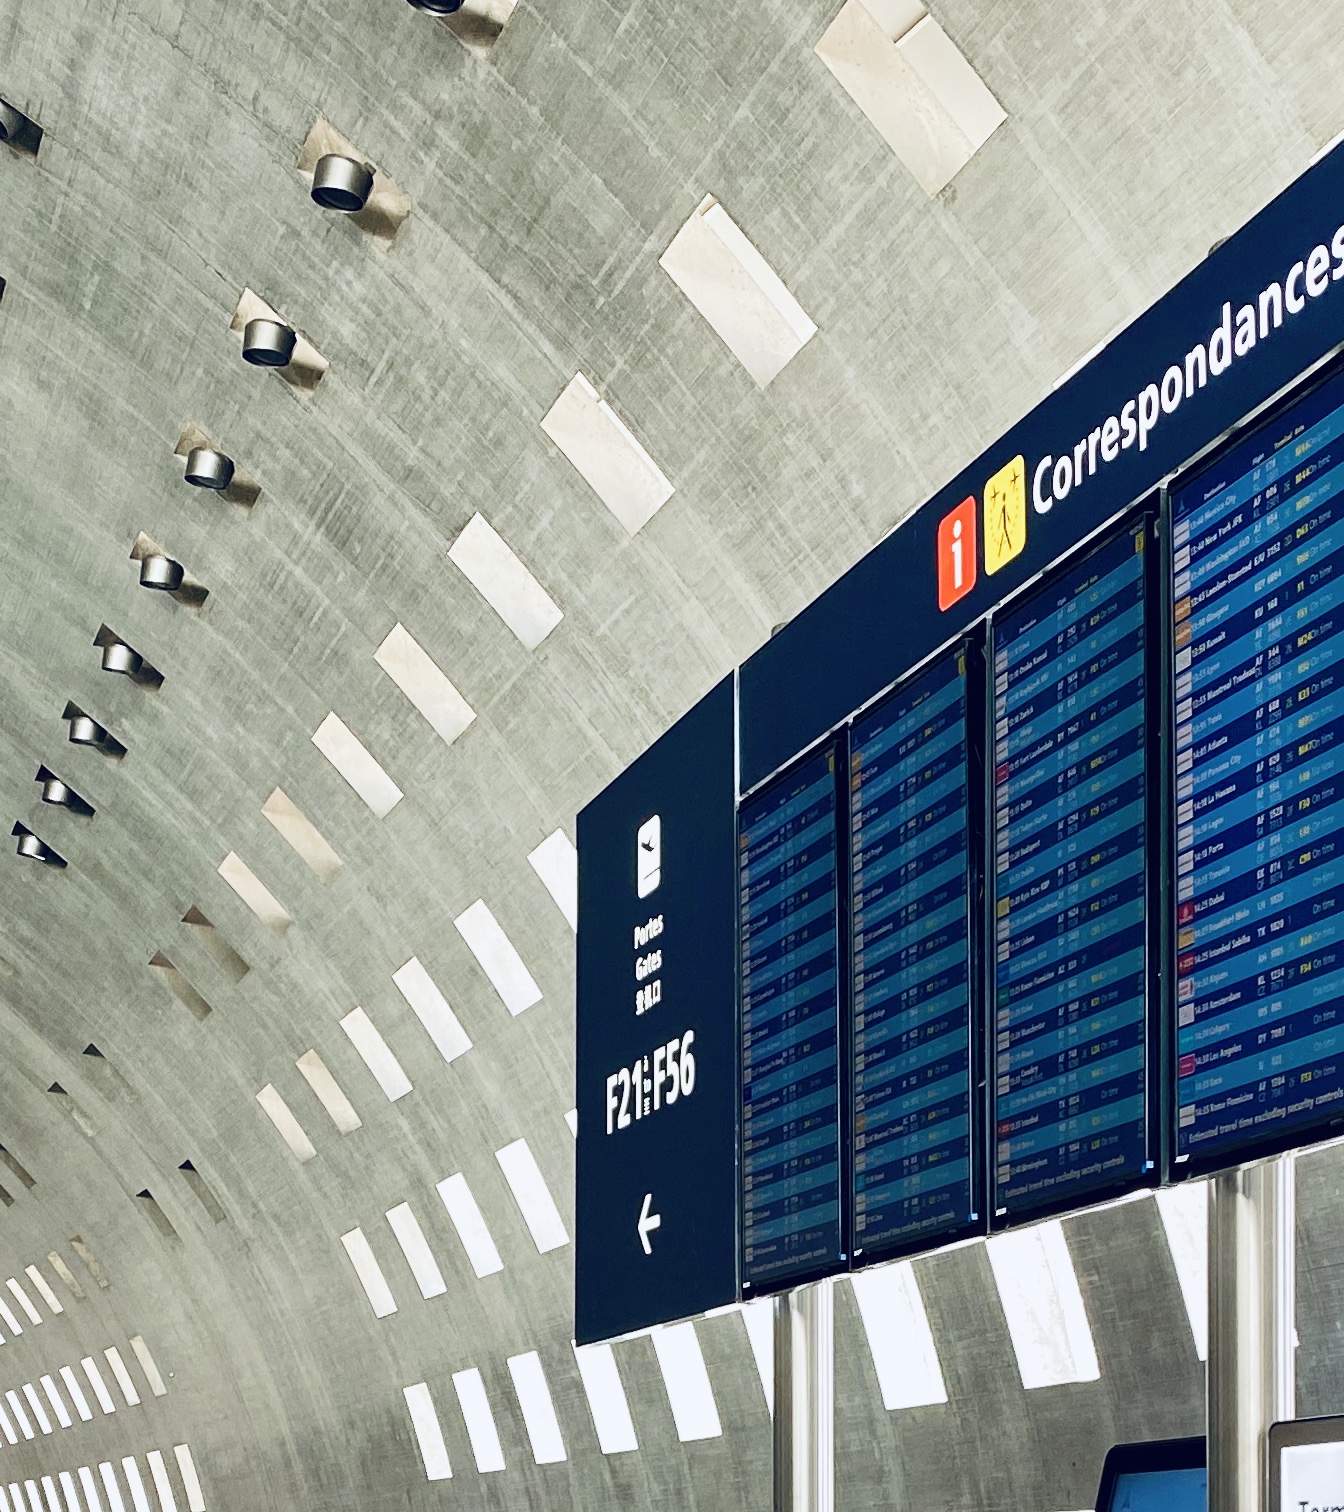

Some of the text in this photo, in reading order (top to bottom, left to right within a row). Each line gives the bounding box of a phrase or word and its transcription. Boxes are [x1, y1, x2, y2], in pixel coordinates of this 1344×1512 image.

[634, 914, 664, 949] Portes
[635, 950, 662, 981] Gates
[606, 1029, 695, 1135] F21 F56
